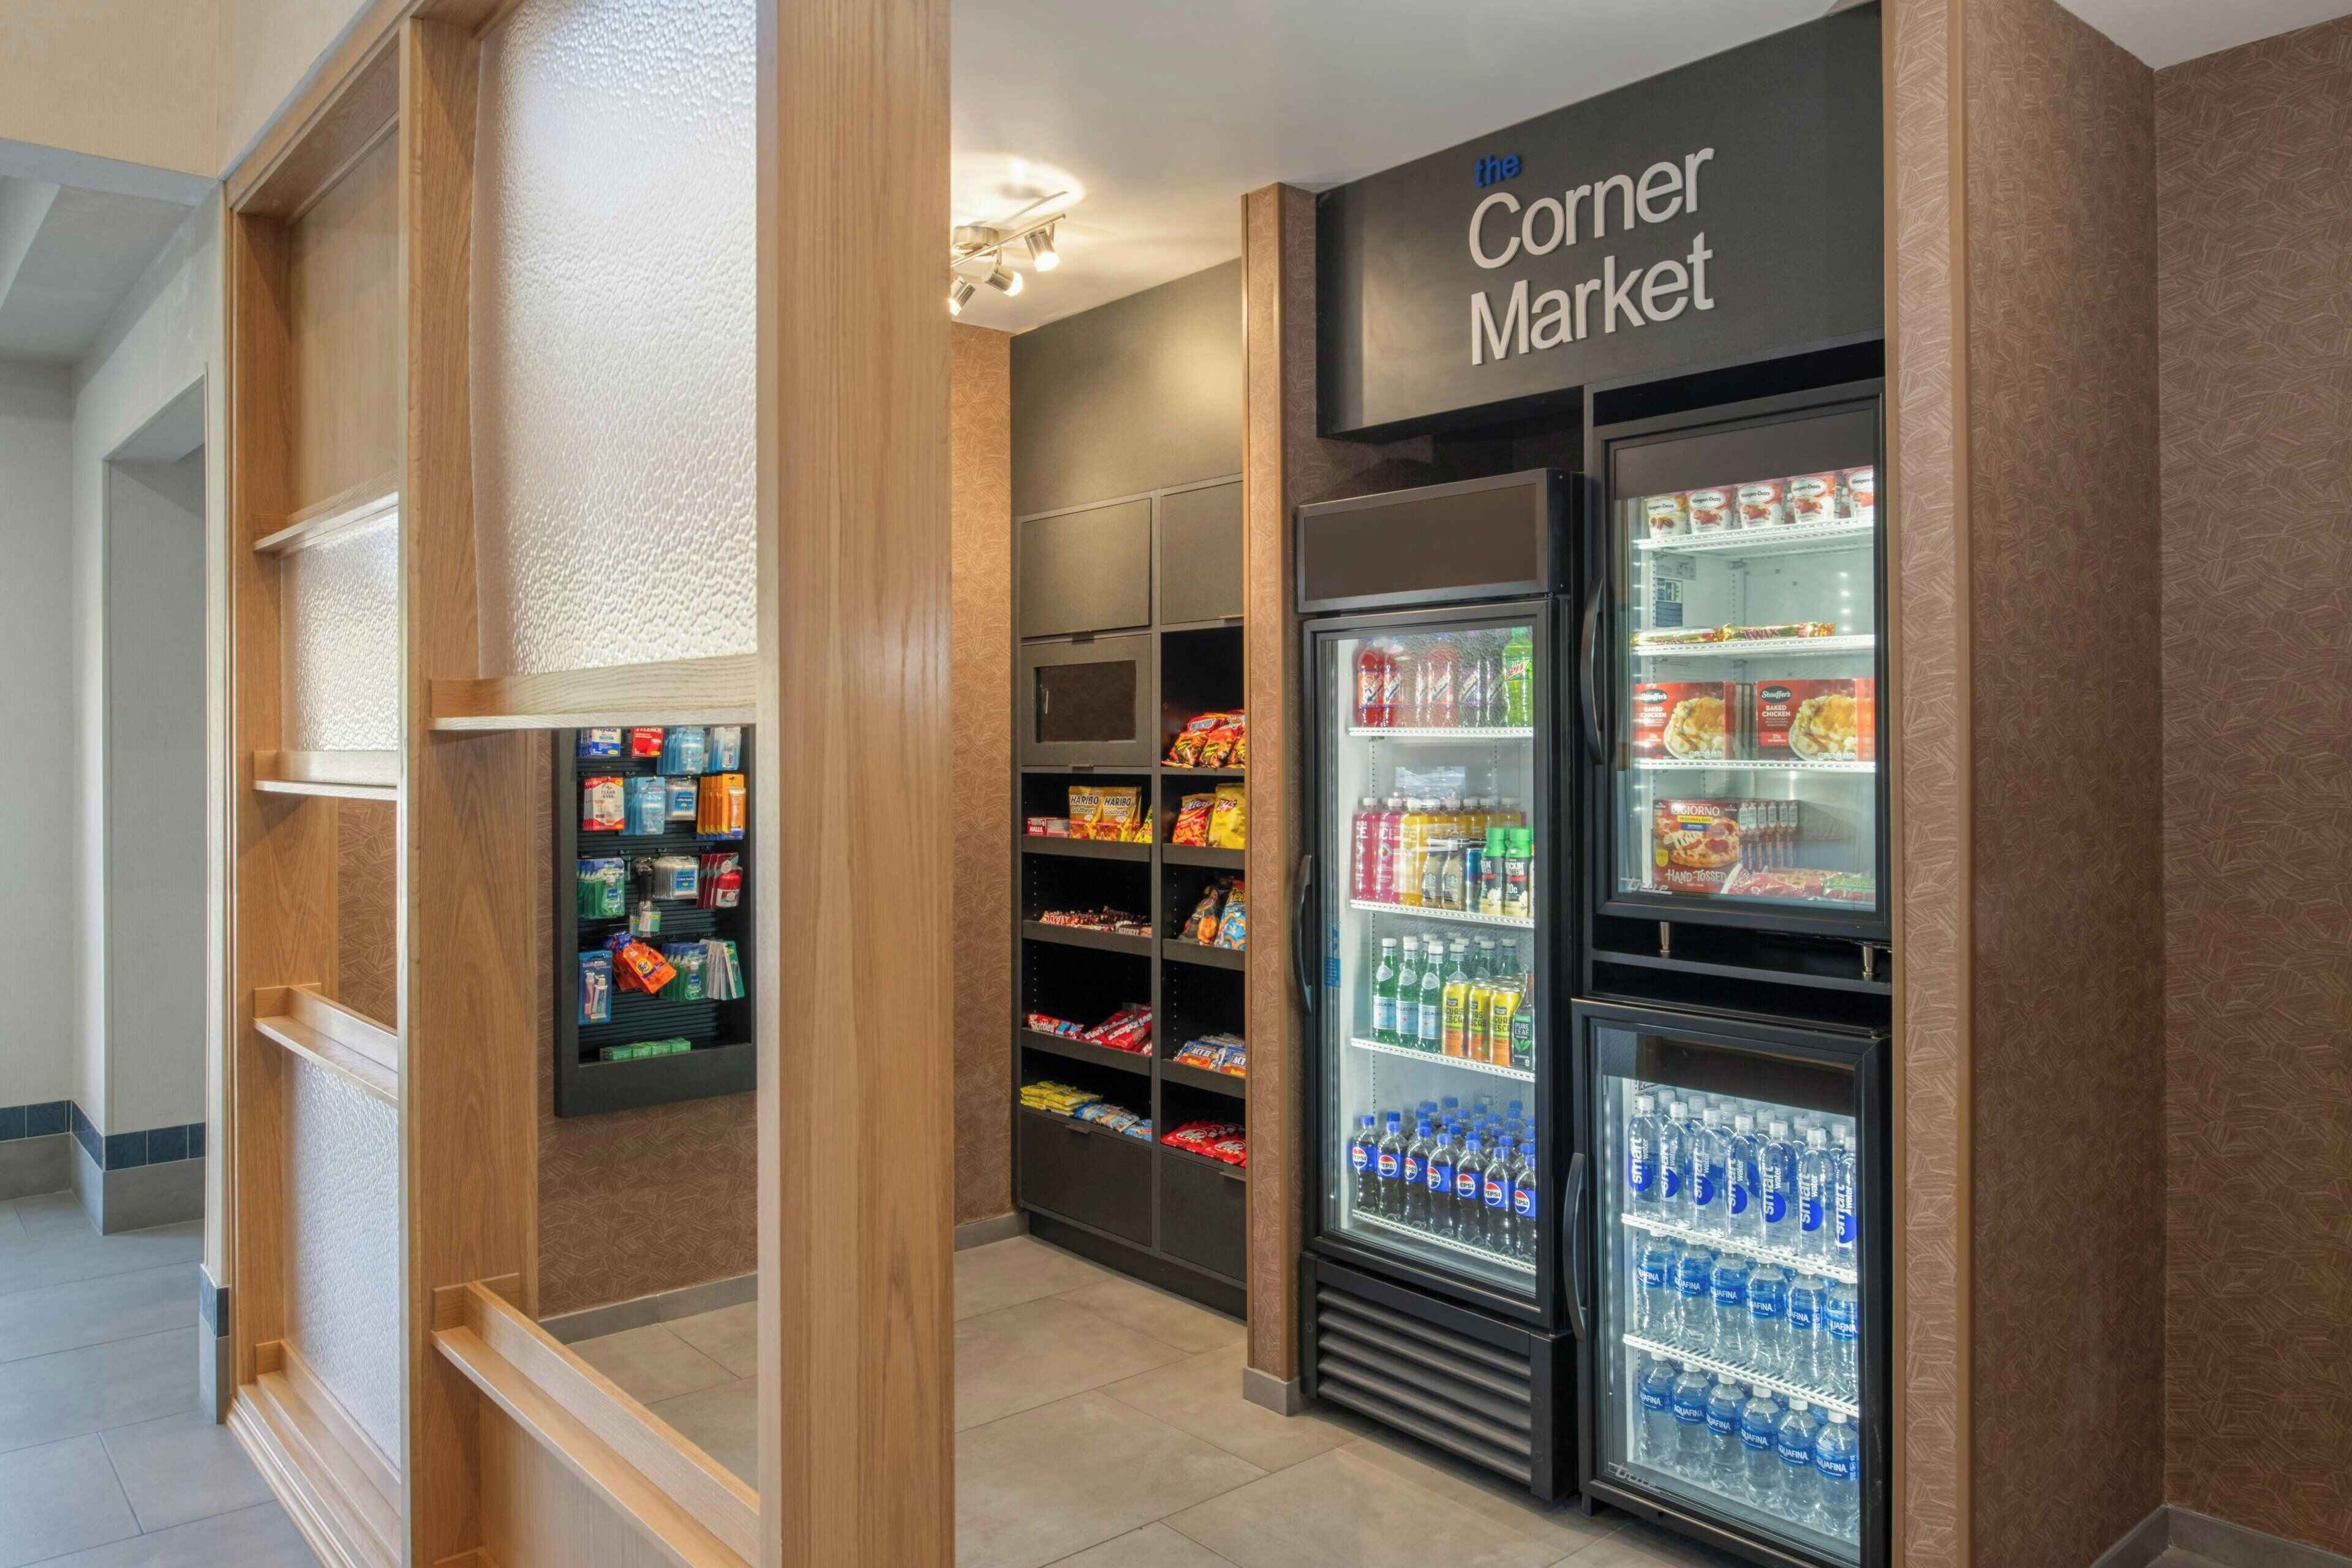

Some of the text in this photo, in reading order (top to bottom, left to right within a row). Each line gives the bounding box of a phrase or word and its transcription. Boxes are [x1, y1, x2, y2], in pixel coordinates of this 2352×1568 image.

[1474, 153, 1521, 187] the
[1469, 148, 1714, 269] Corner
[1471, 232, 1714, 366] Market
[1742, 627, 1781, 641] TWIX
[1761, 690, 1792, 699] Stouffer's
[1071, 795, 1099, 805] HARIBO
[1104, 797, 1131, 807] HARIBO
[1506, 862, 1525, 870] OCKIN'
[638, 960, 650, 971] Tide
[1031, 1021, 1055, 1033] Skittles
[1630, 1137, 1642, 1184] smart
[1764, 1166, 1774, 1215] smart
[1800, 1173, 1811, 1224] smart
